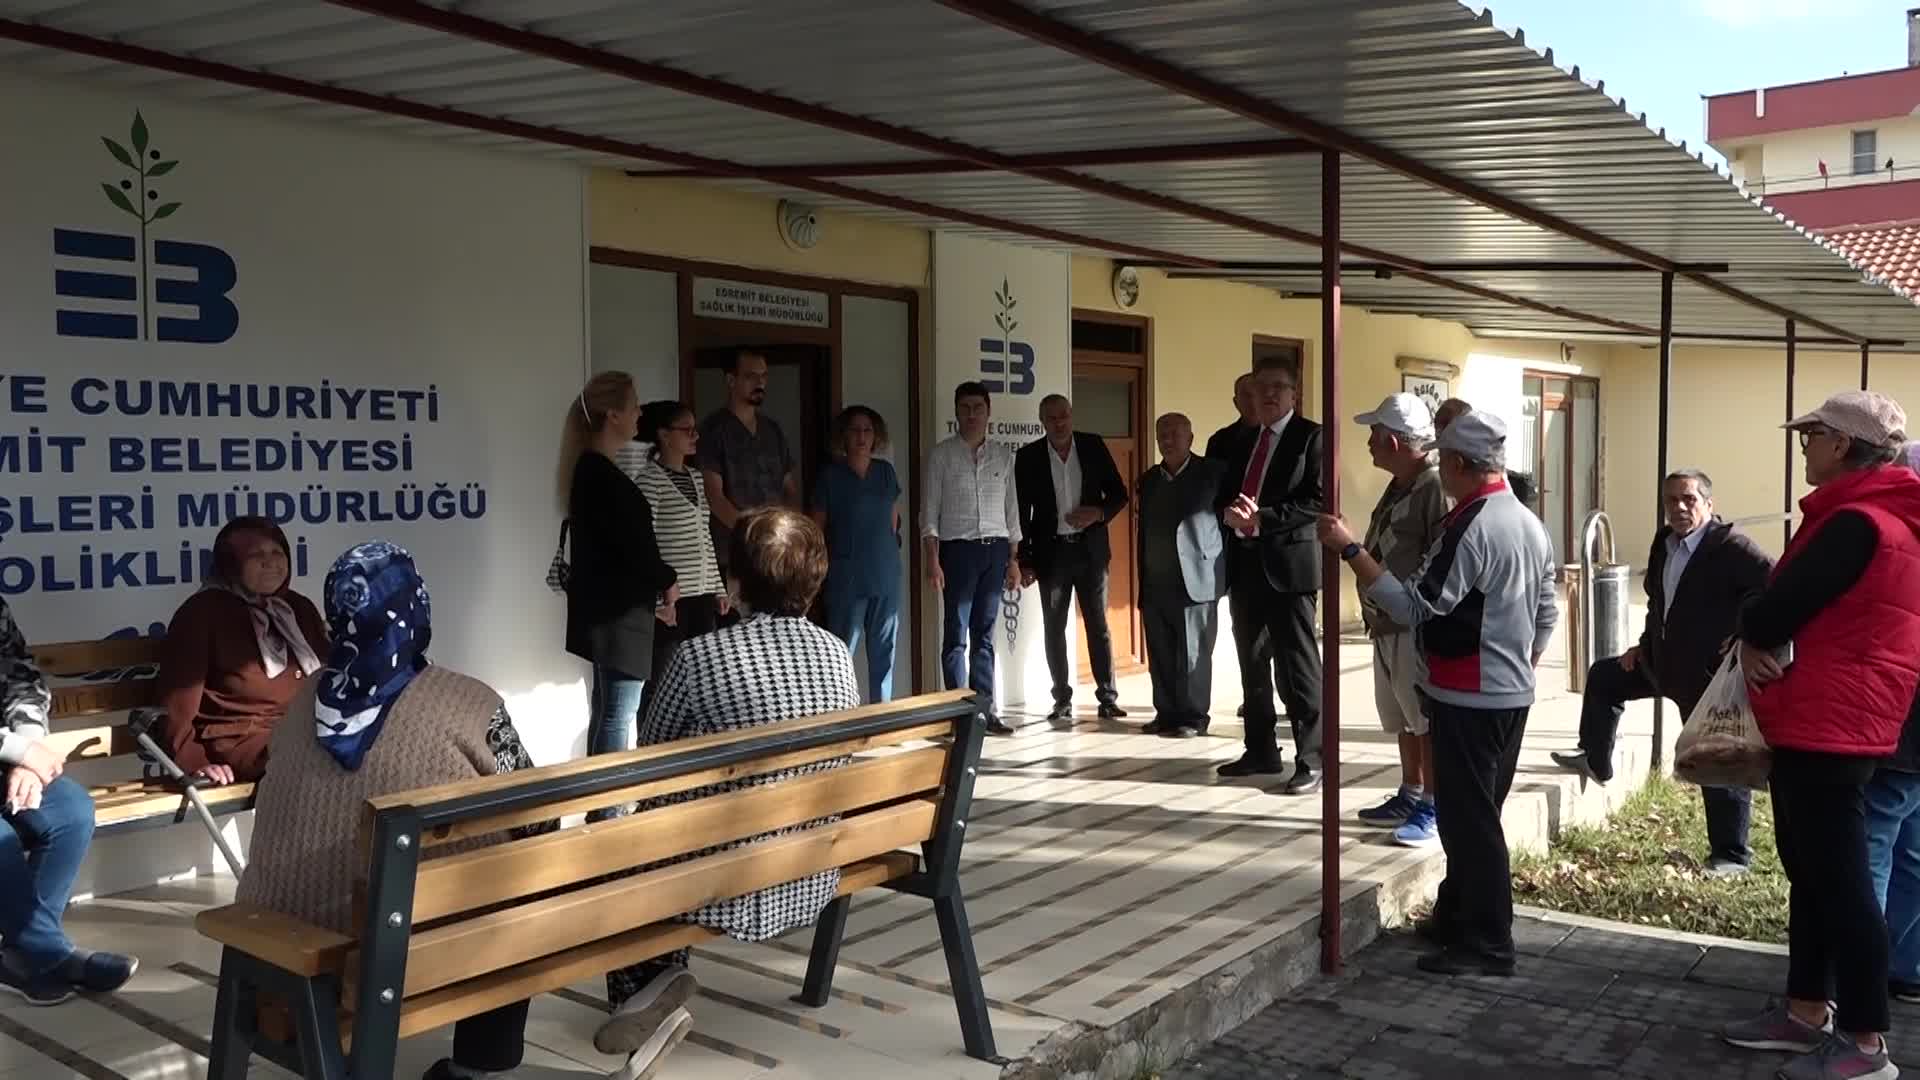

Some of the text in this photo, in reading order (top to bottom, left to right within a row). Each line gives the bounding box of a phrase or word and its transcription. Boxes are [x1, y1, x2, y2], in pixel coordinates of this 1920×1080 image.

[737, 303, 767, 317] İŞLERİ
[758, 293, 810, 306] BELEDİYESİ
[71, 378, 438, 422] CUMHURİYETİ
[109, 432, 413, 472] BELEDİYESİ
[178, 482, 486, 527] MÜDÜRLÜĞÜ
